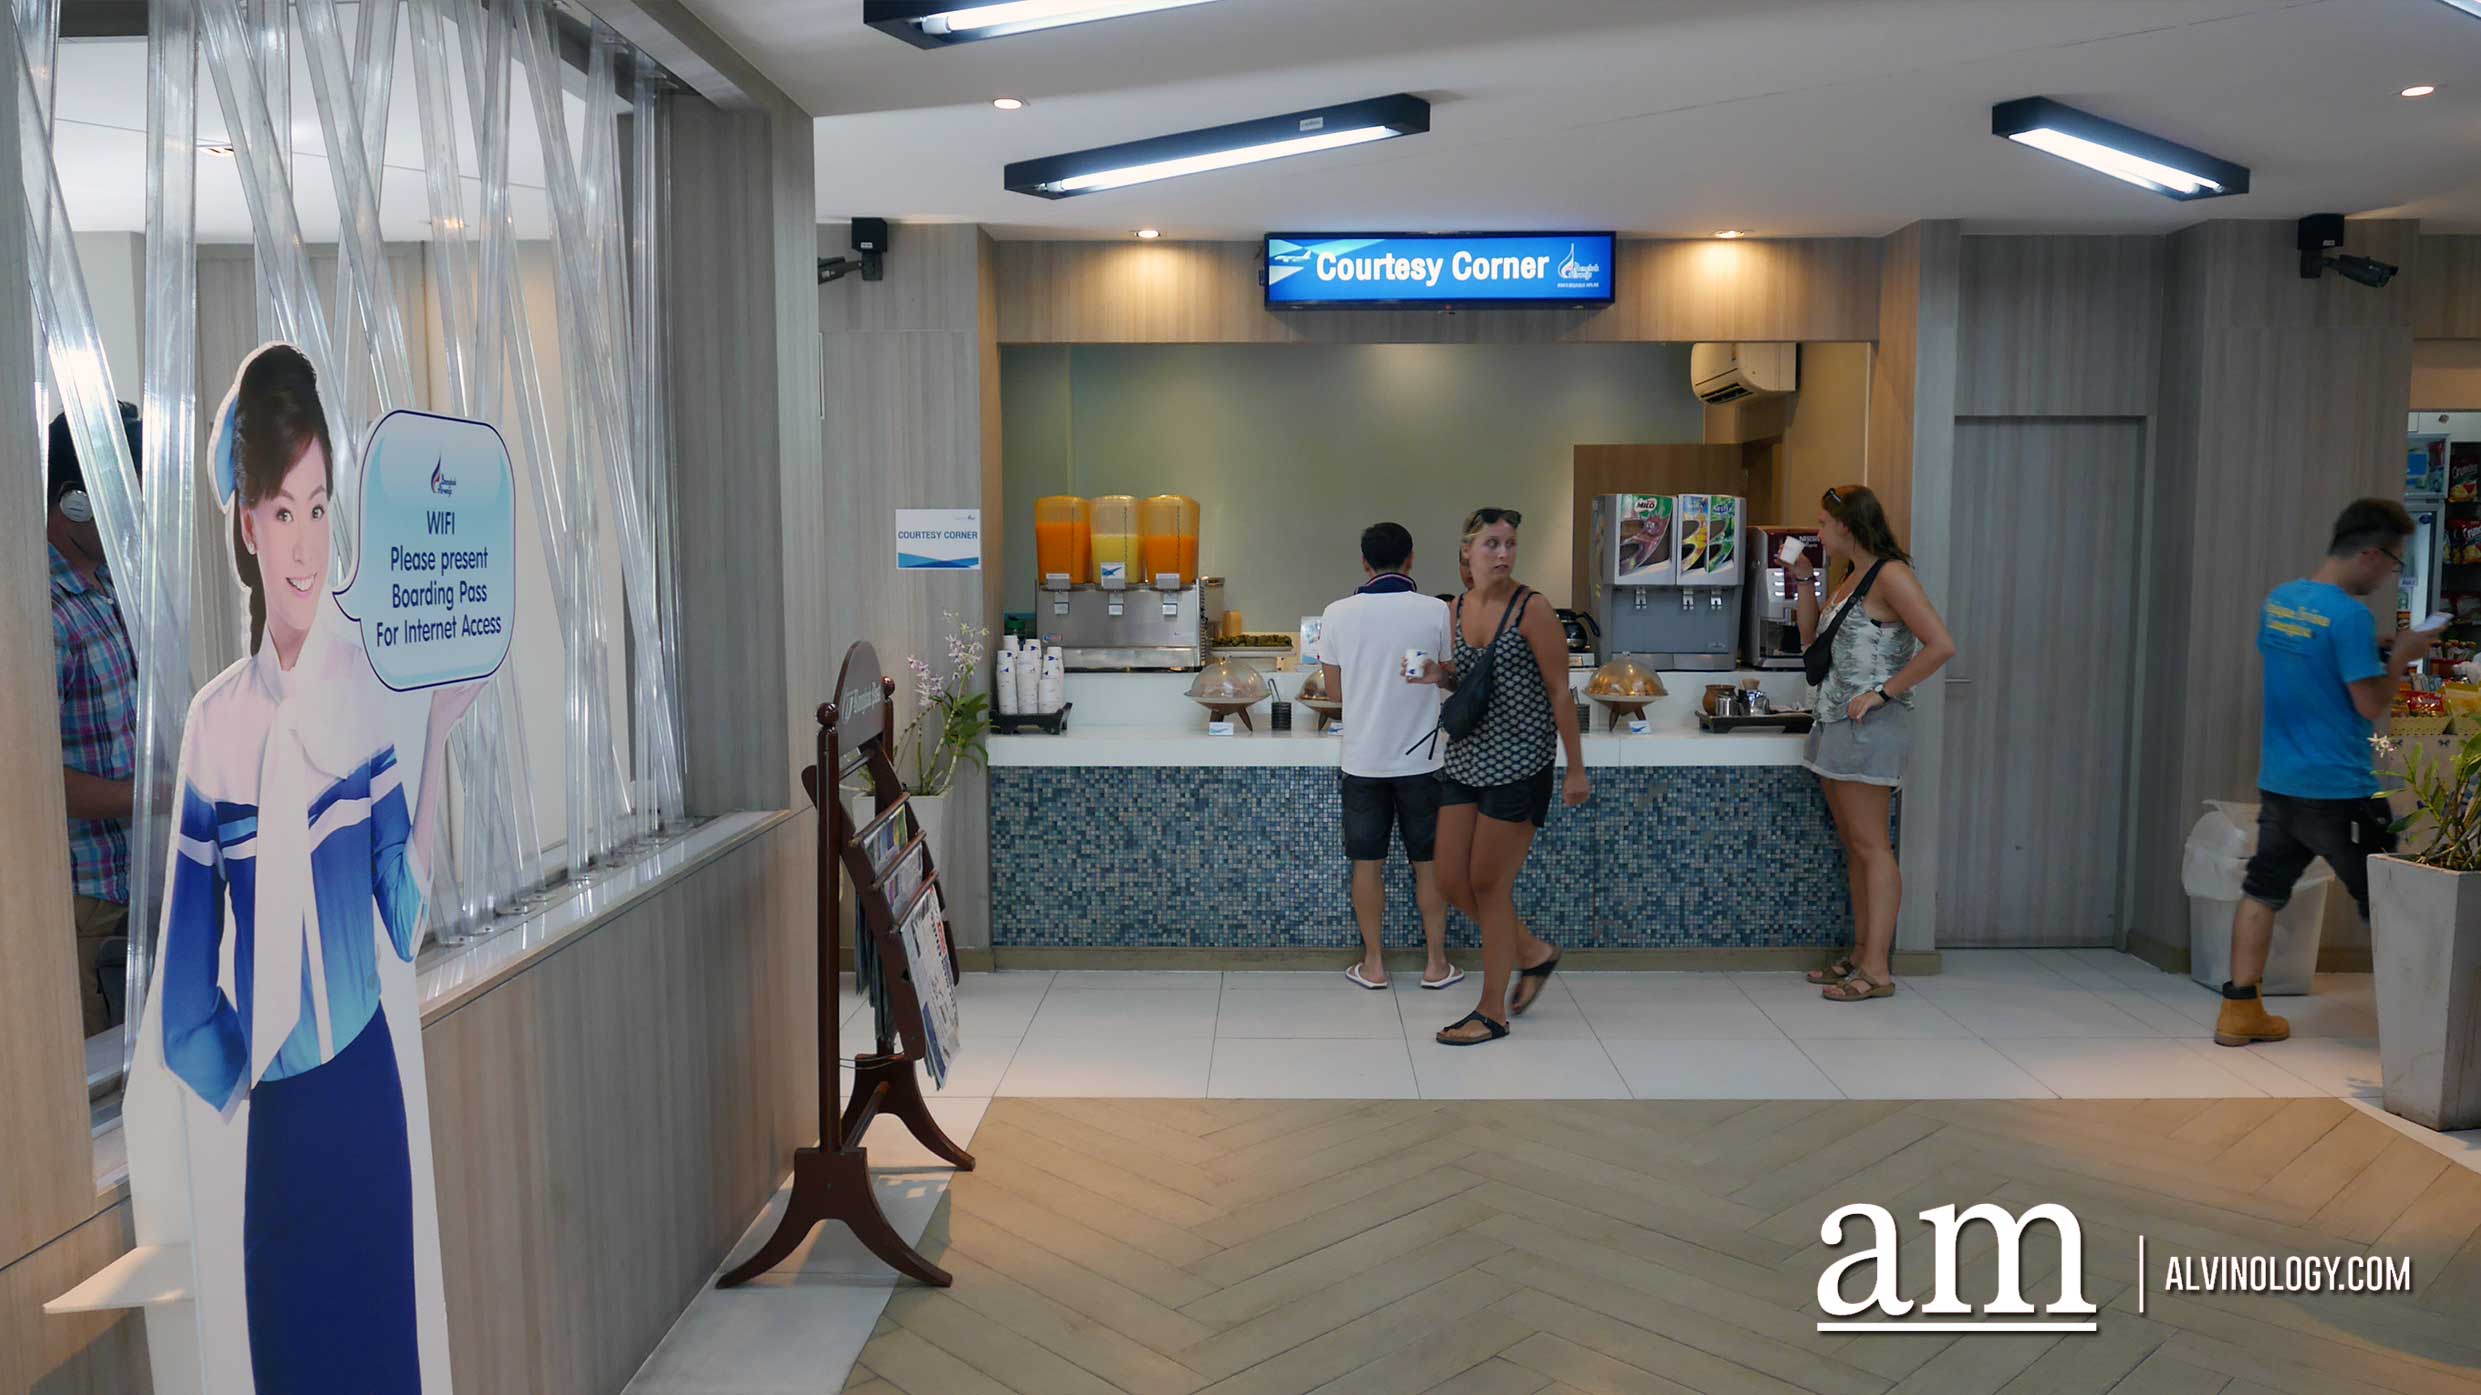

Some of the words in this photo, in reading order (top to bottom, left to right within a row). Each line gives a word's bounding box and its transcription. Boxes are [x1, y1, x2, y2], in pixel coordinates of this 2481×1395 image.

[1316, 252, 1444, 287] Courtesy
[1452, 251, 1550, 281] Corner
[1636, 501, 1655, 509] MILO
[426, 510, 456, 535] WIFI
[897, 530, 942, 540] COURTESY
[943, 530, 978, 540] CORNER
[391, 545, 436, 572] Please
[441, 546, 488, 576] present
[391, 580, 454, 611] Boarding
[459, 580, 488, 604] Pass
[376, 621, 399, 647] For
[404, 615, 457, 644] Internet
[461, 613, 502, 637] Access
